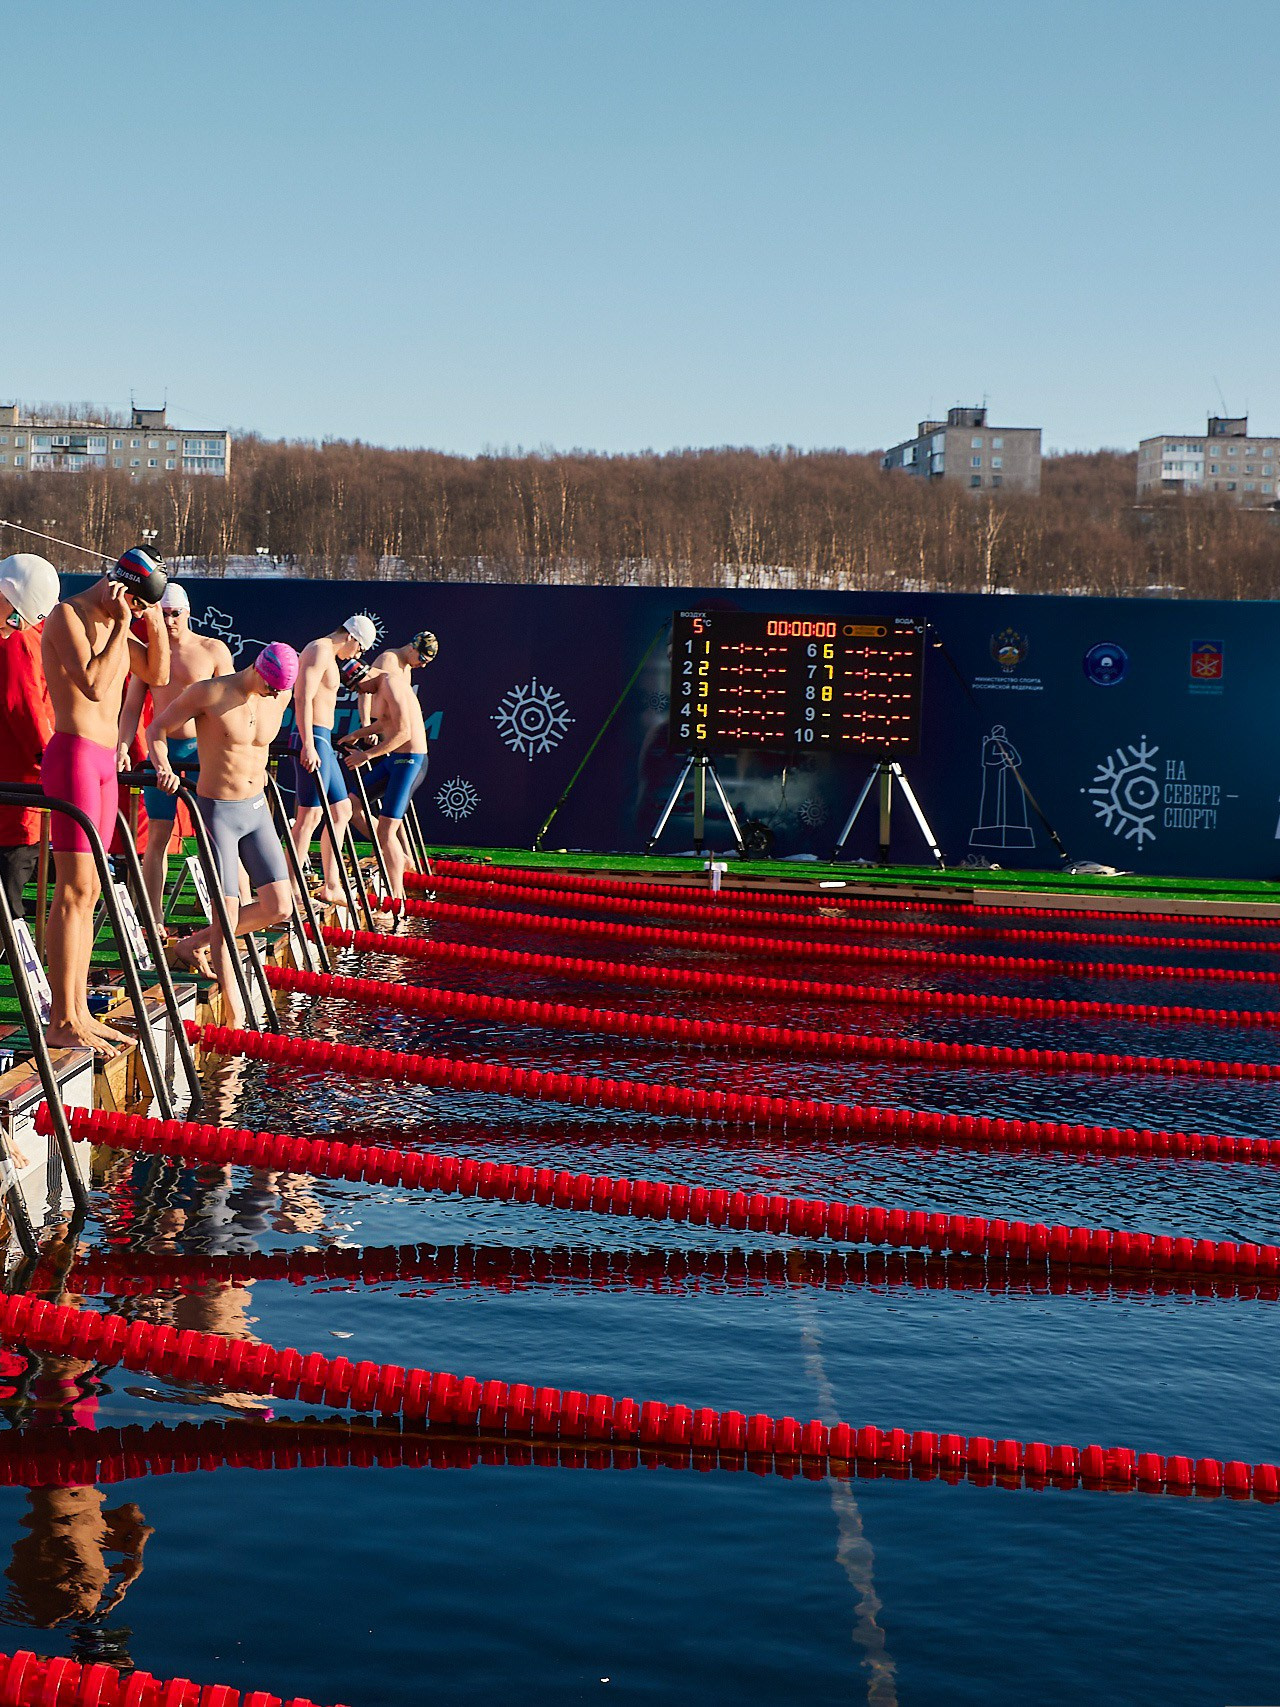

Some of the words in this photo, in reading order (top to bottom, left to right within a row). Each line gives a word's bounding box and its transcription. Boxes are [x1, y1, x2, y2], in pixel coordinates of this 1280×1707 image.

[116, 567, 141, 584] RUSSIA
[693, 618, 704, 634] 5
[767, 620, 837, 638] 00:00:00
[684, 640, 693, 654] 1
[807, 643, 818, 657] 6
[823, 643, 834, 659] 6
[683, 661, 693, 674] 2
[699, 661, 709, 676] 2
[807, 665, 818, 679] 7
[824, 664, 834, 680] 7
[682, 682, 692, 696] 3
[698, 682, 708, 697] 3
[805, 686, 816, 700] 8
[821, 686, 833, 701] 8
[681, 703, 691, 716] 4
[697, 703, 708, 718] 4
[805, 707, 816, 721] 9
[680, 724, 690, 737] 5
[696, 723, 707, 739] 5
[794, 728, 814, 742] 10
[1165, 760, 1187, 780] НА
[1164, 783, 1220, 806] СЕВЕРЕ
[1164, 807, 1217, 829] СПОРТ!
[18, 928, 41, 984] 4
